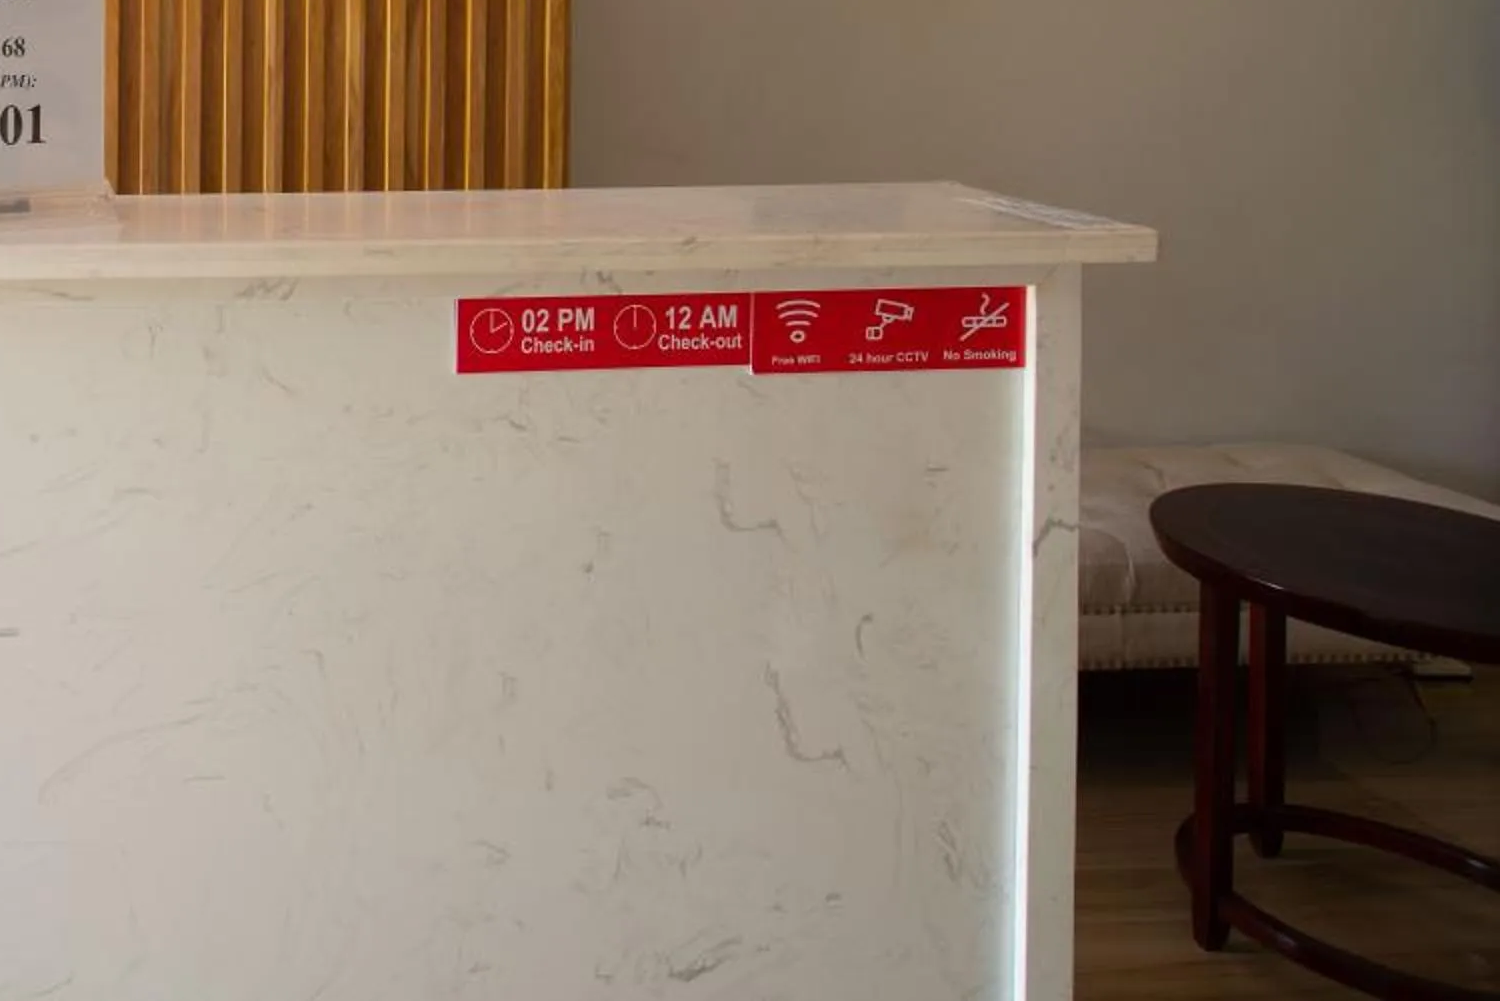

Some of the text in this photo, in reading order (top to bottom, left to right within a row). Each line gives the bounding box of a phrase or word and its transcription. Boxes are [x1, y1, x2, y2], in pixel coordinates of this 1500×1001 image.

[521, 307, 595, 332] 02 PM
[665, 304, 738, 330] 12 AM
[520, 337, 594, 354] Check-in
[657, 333, 742, 350] Check-out
[850, 351, 929, 364] 24 hour CCTV
[943, 349, 1017, 362] No Smoking
